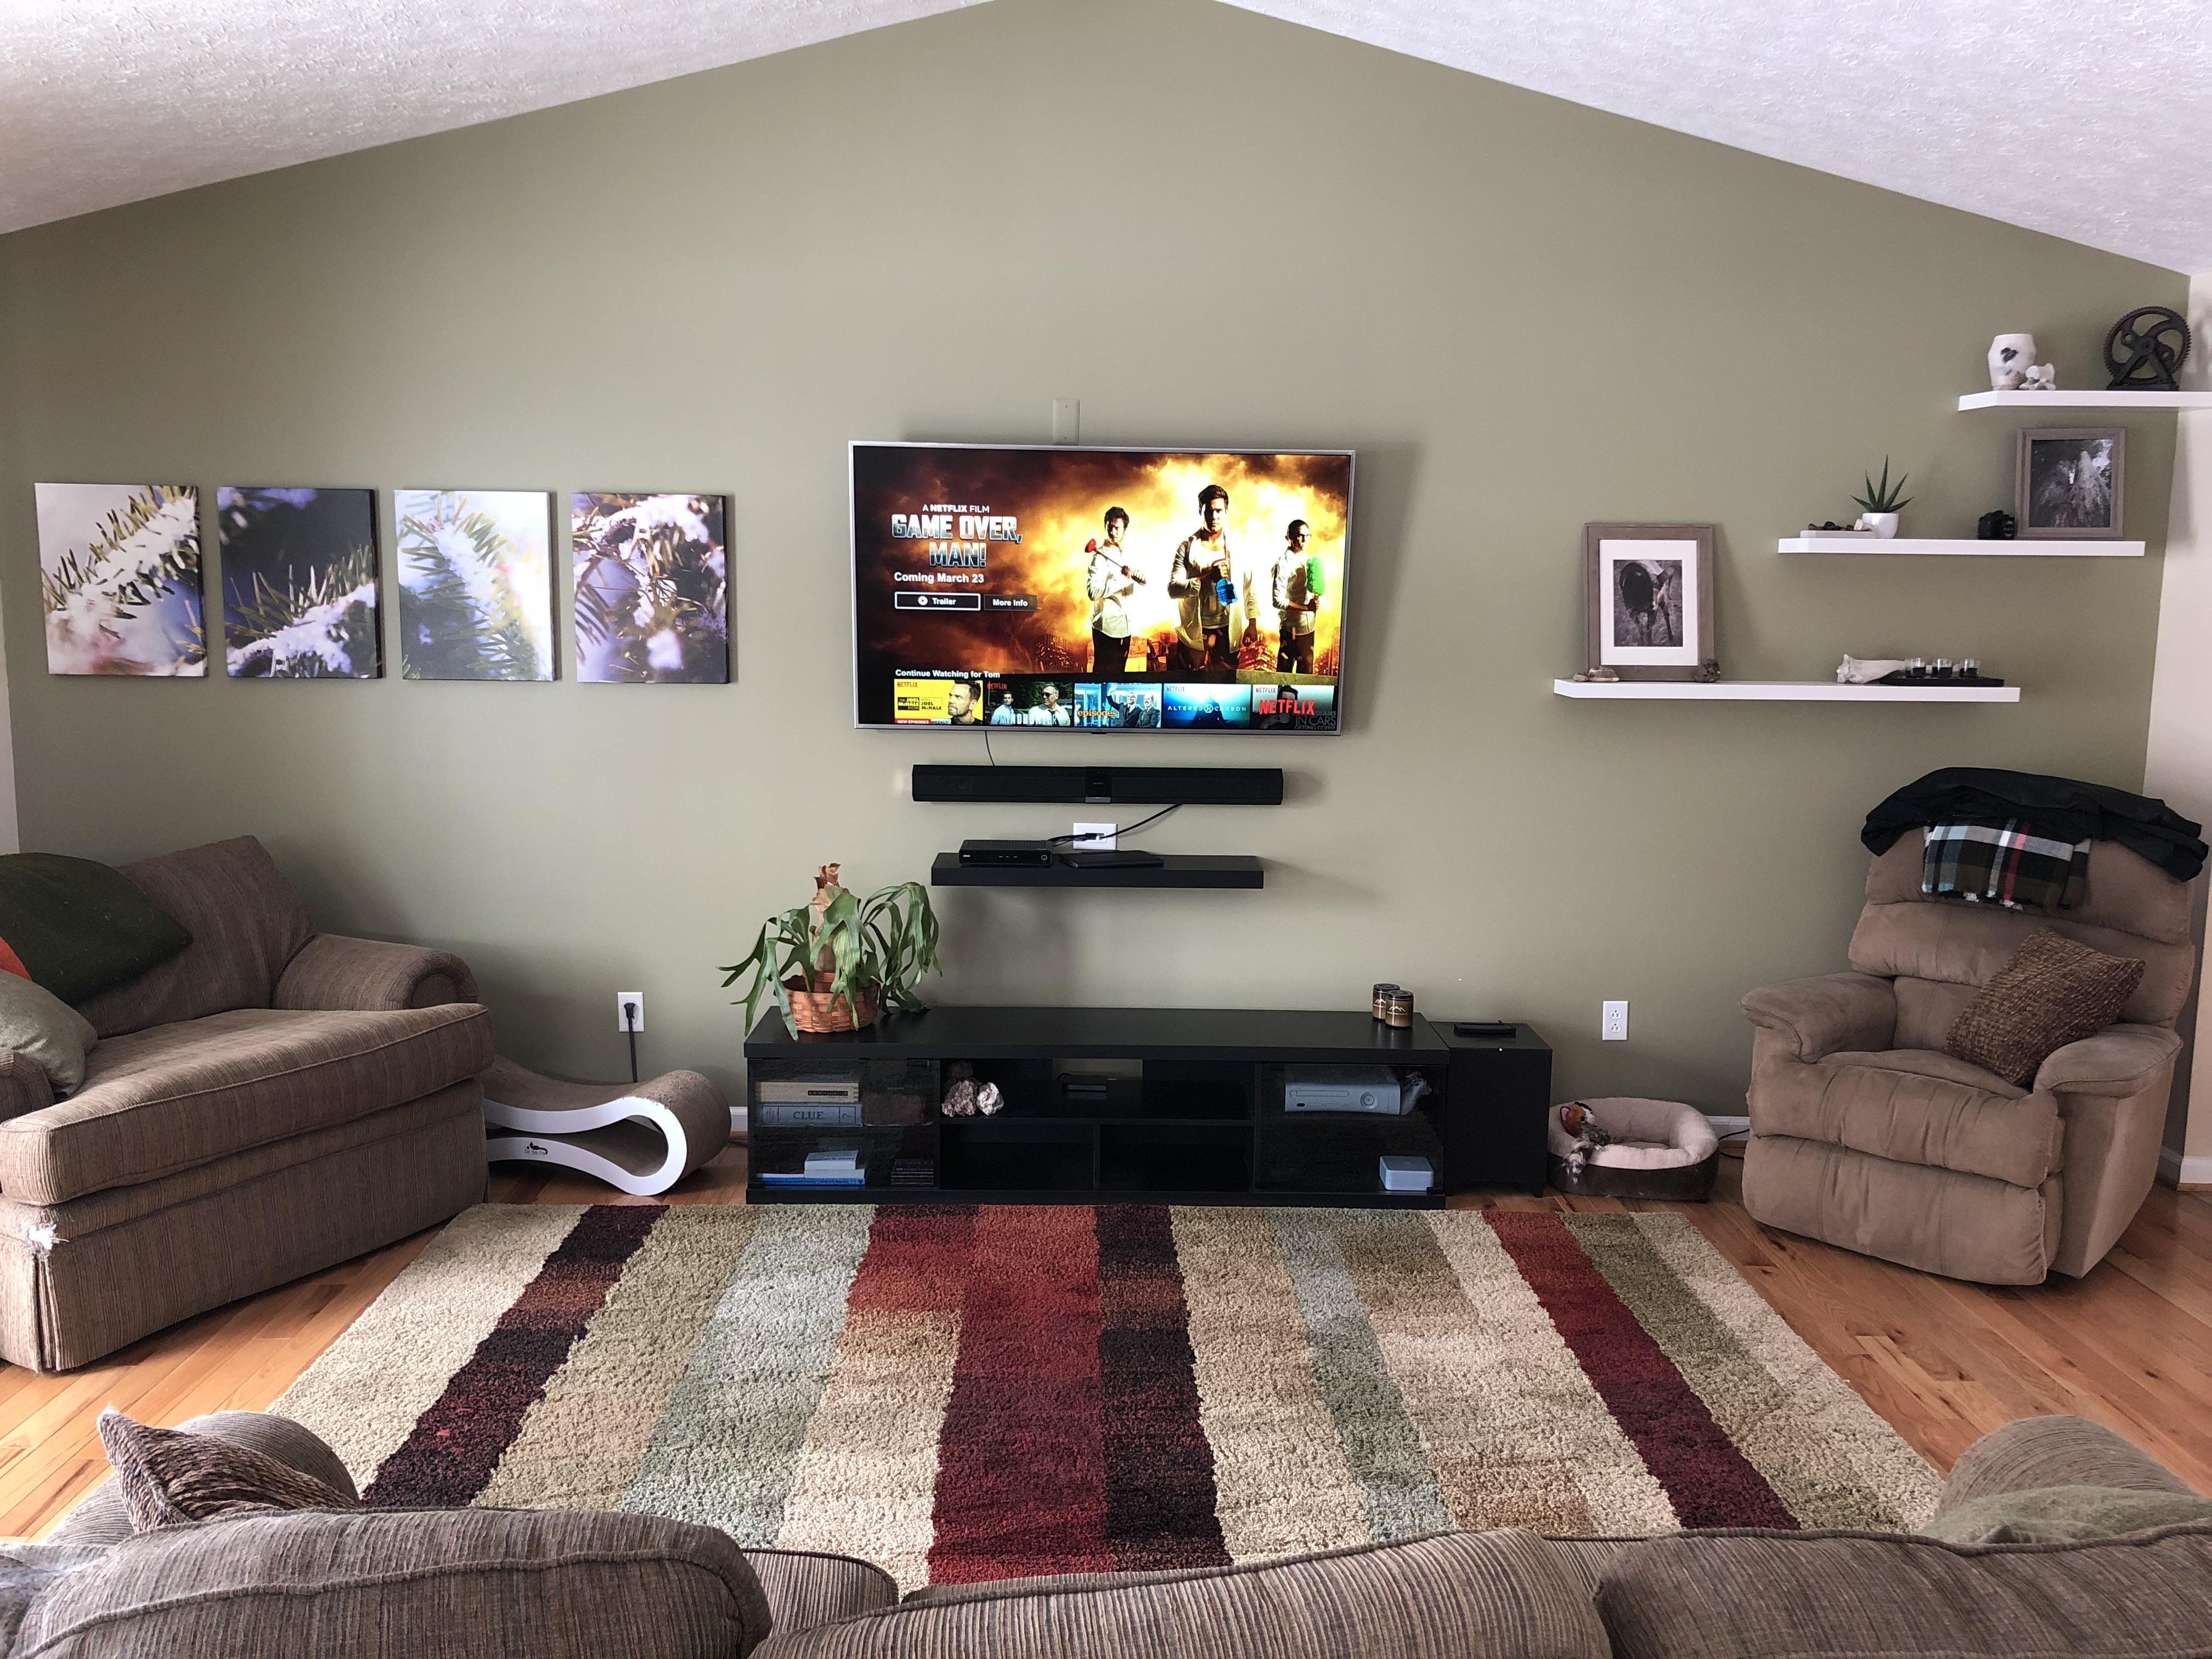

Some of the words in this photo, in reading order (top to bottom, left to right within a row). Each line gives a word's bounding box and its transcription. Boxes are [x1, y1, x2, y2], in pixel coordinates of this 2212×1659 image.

[930, 504, 967, 512] NETFLIX
[891, 514, 953, 539] GAME
[959, 515, 1023, 544] OVER,
[929, 541, 987, 567] MAN!
[894, 572, 934, 584] Coming
[937, 572, 969, 583] March
[972, 574, 985, 583] 23
[992, 599, 1012, 607] More
[895, 669, 931, 677] Continue
[932, 669, 969, 679] Watching
[1077, 708, 1118, 718] episodes
[1259, 699, 1316, 716] NETFLIX
[1000, 713, 1057, 725] MINDHUNTER
[1295, 715, 1307, 725] IN
[1308, 715, 1336, 726] CARS
[793, 1111, 825, 1120] CLUE
